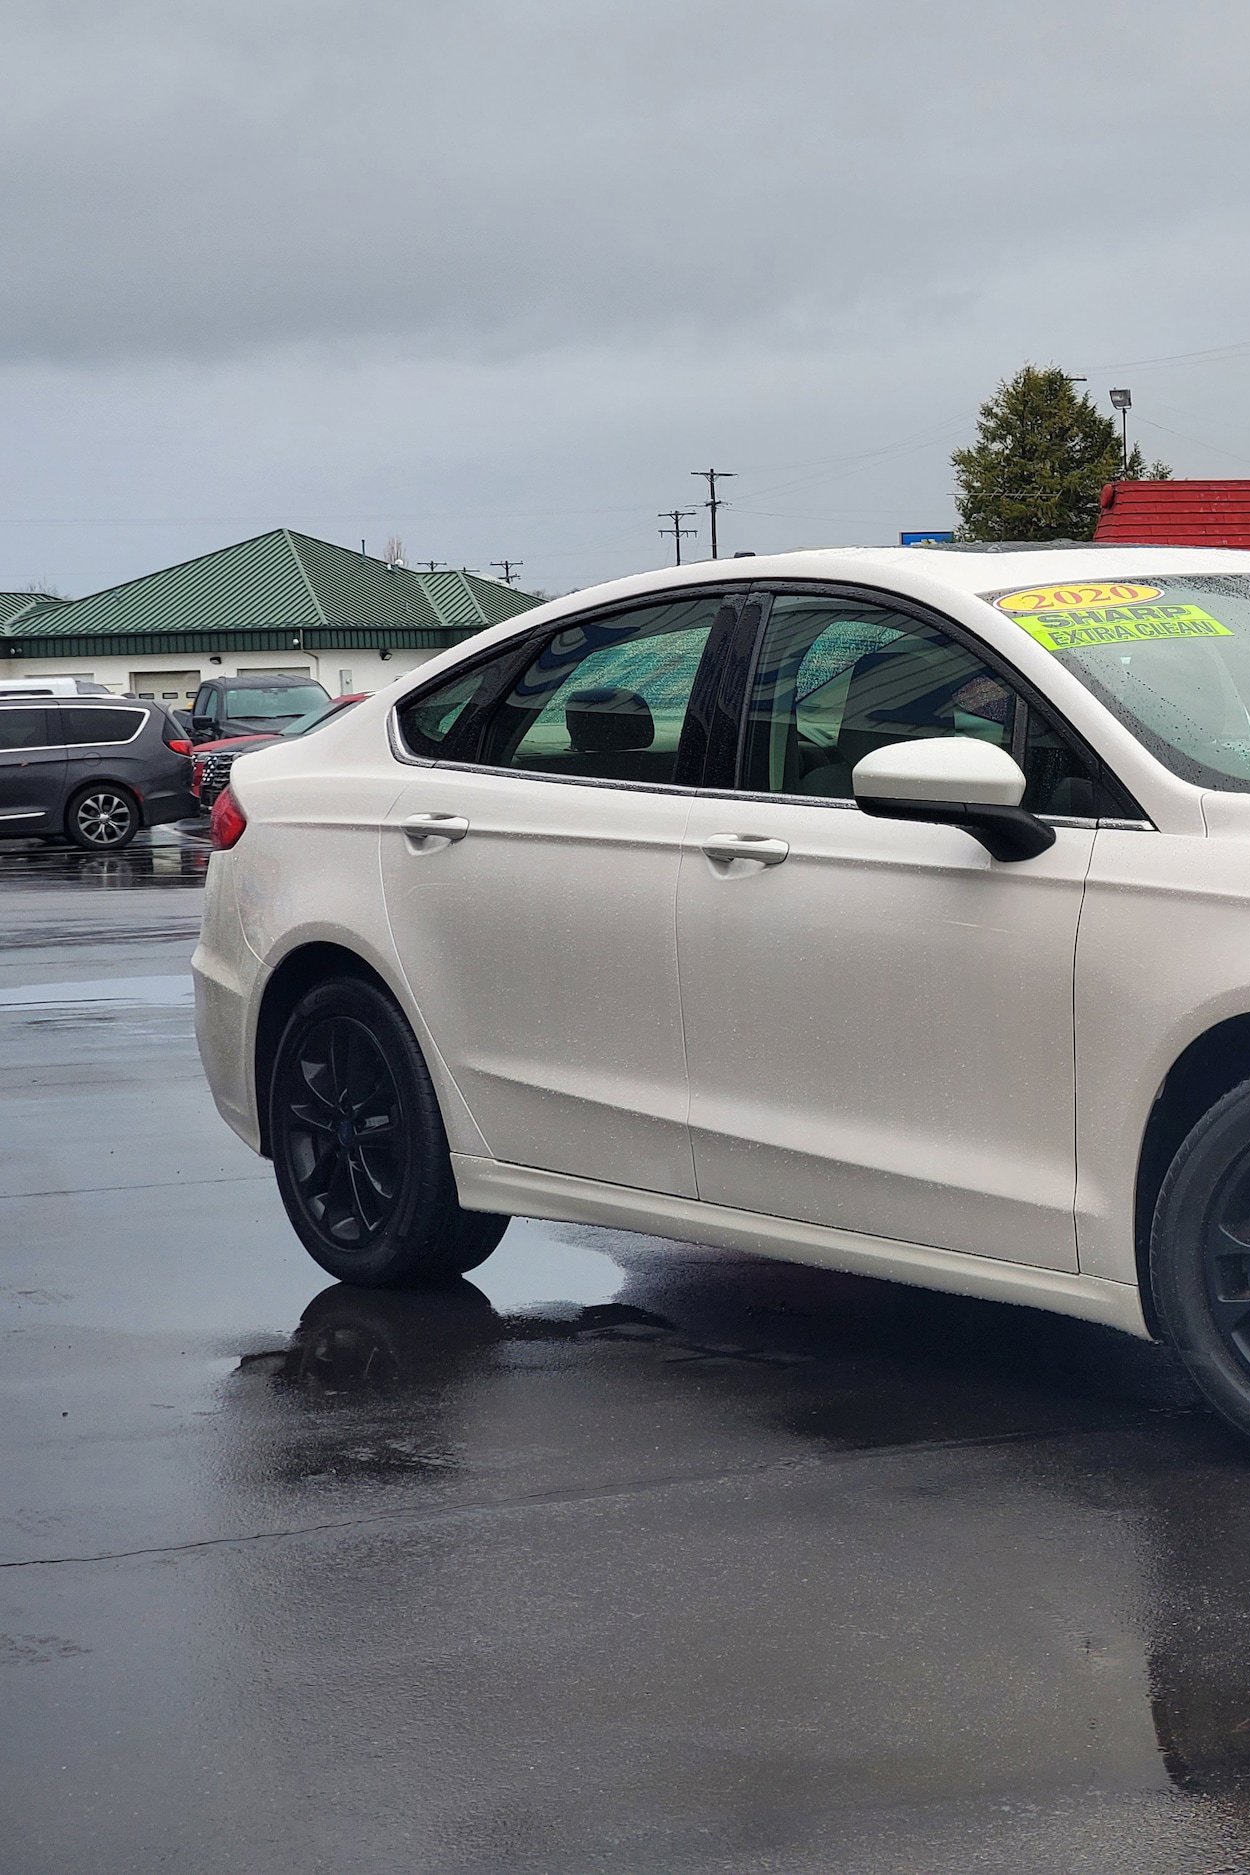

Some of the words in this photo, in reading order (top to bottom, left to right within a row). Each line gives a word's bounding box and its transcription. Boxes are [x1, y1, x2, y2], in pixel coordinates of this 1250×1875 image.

[1022, 585, 1139, 609] 2020
[1037, 606, 1191, 629] SHARP
[1048, 623, 1136, 647] EXTRA
[1135, 620, 1216, 637] CLEAN
